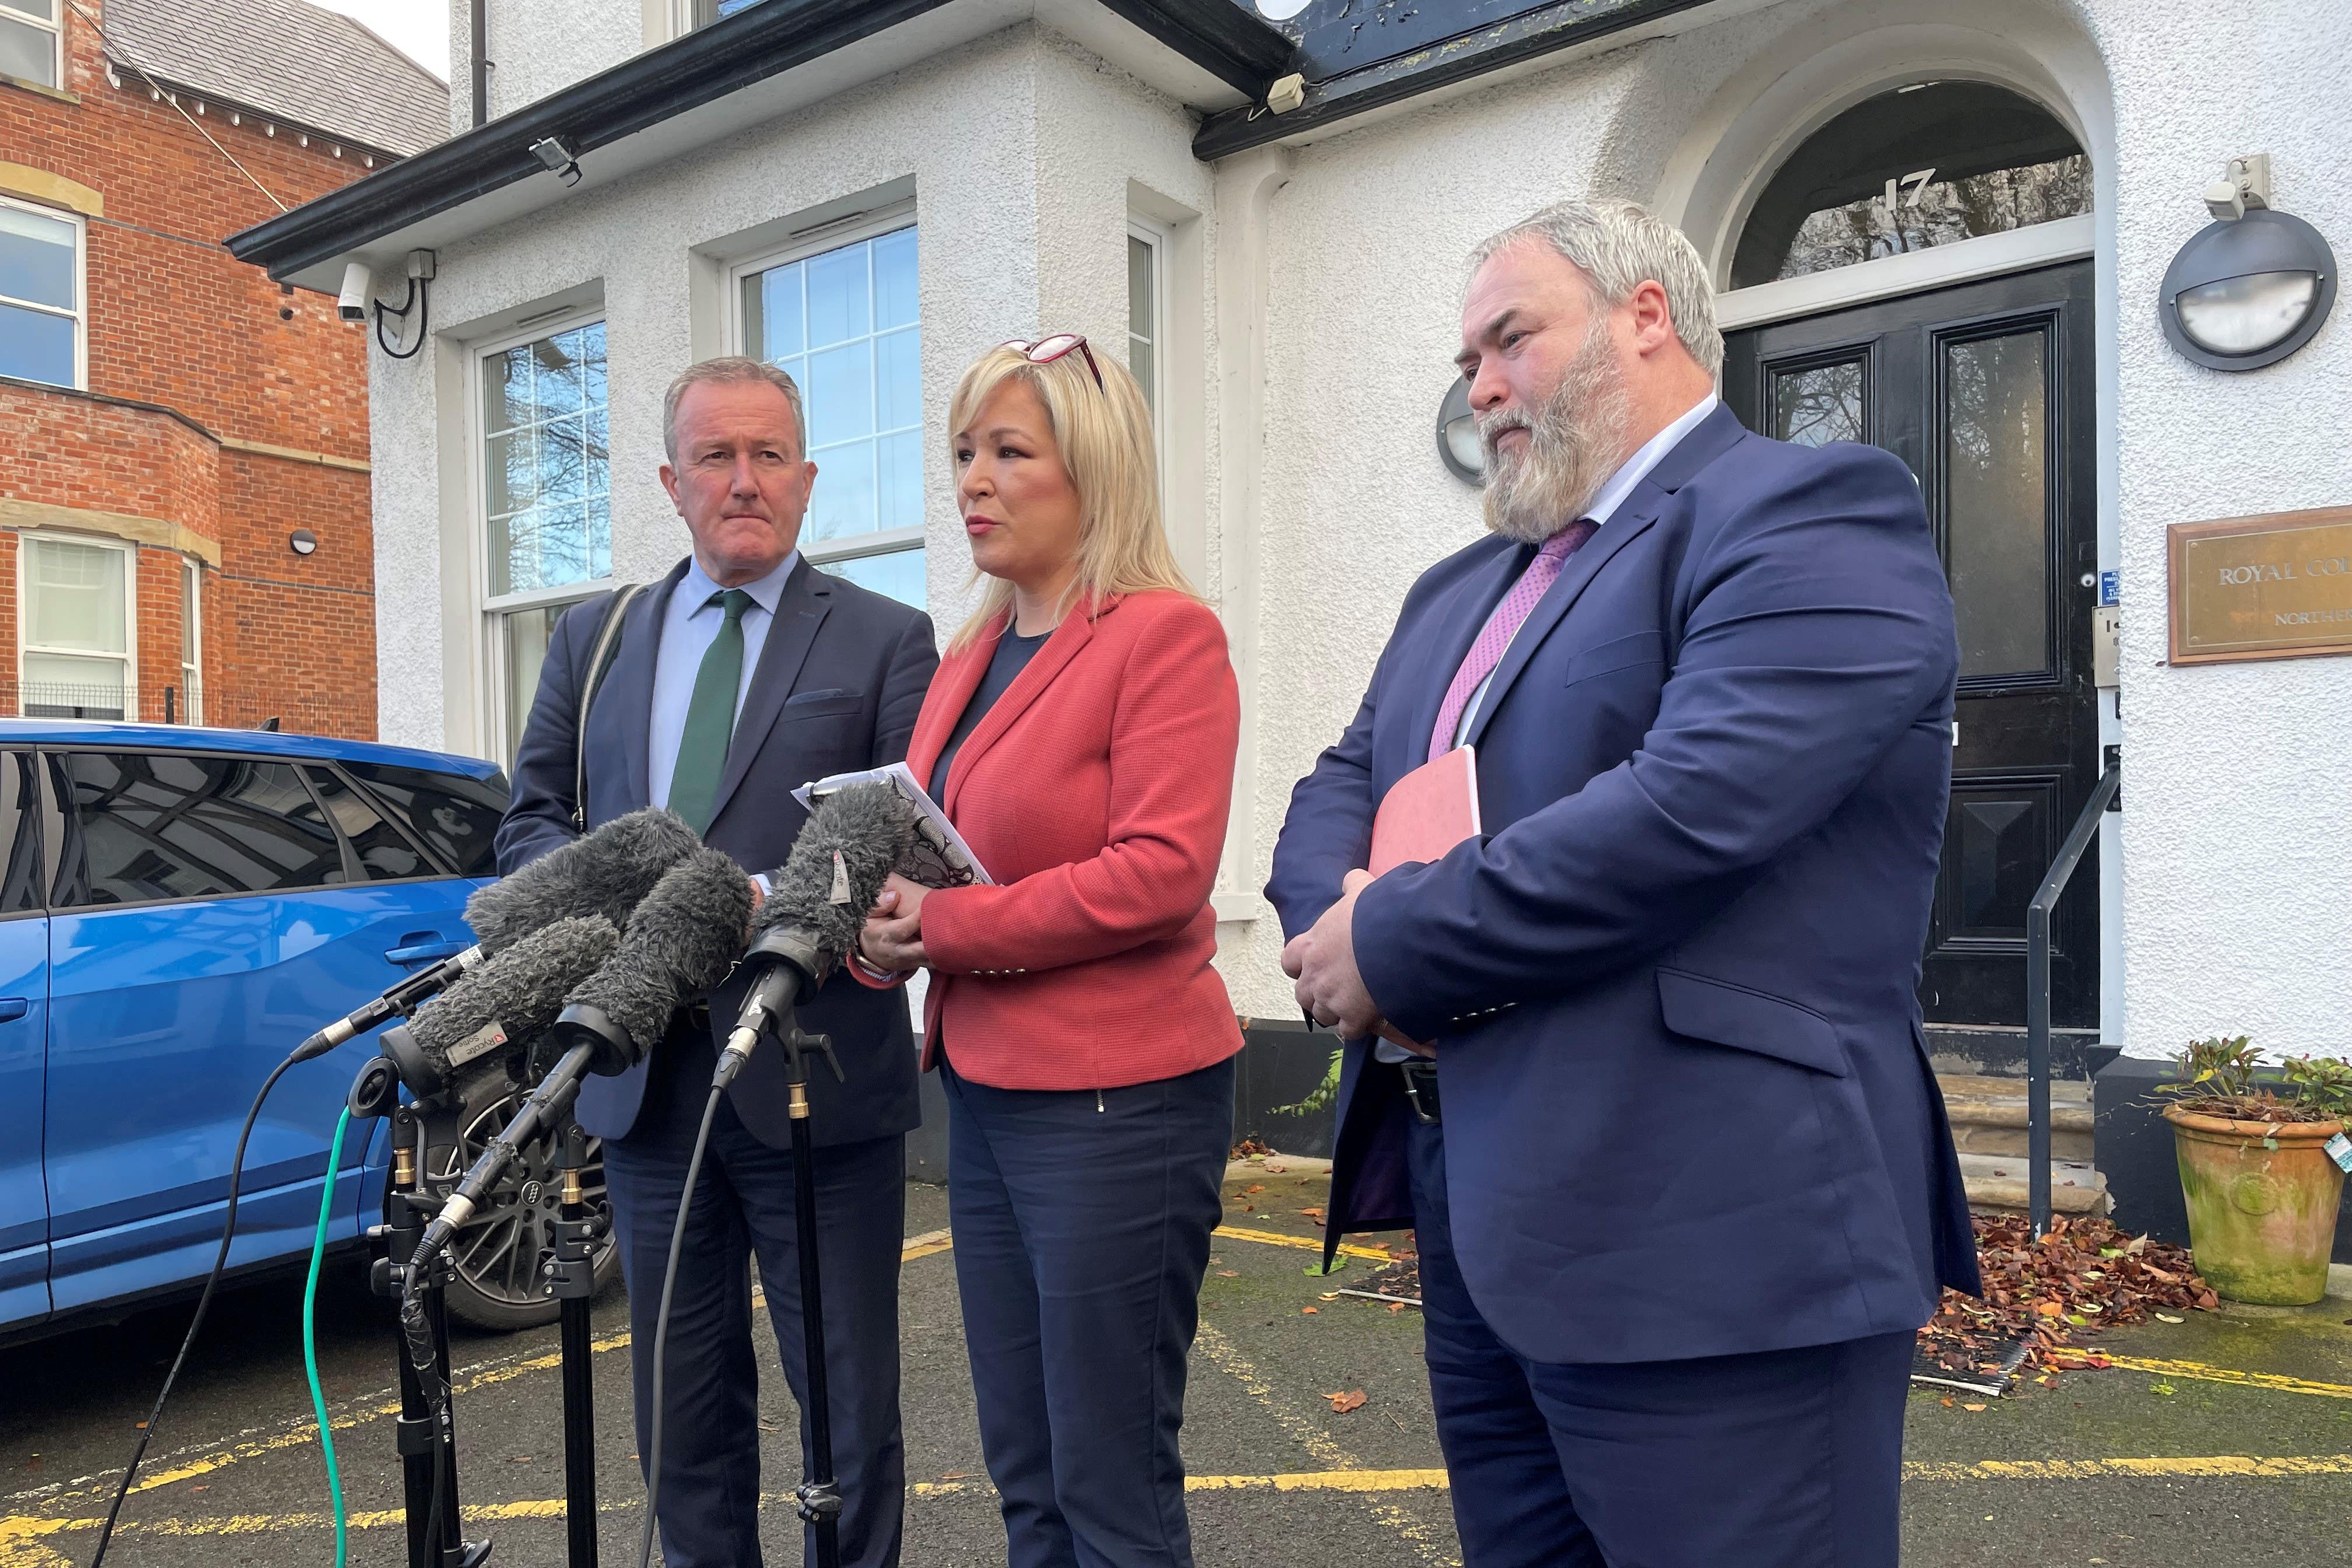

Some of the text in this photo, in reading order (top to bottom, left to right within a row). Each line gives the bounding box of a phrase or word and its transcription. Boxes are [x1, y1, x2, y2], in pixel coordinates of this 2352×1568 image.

[1885, 168, 1936, 211] 17
[2219, 562, 2297, 585] ROYAL
[835, 862, 844, 887] Rycote
[459, 1035, 480, 1048] Softie
[466, 1037, 496, 1055] Rycote
